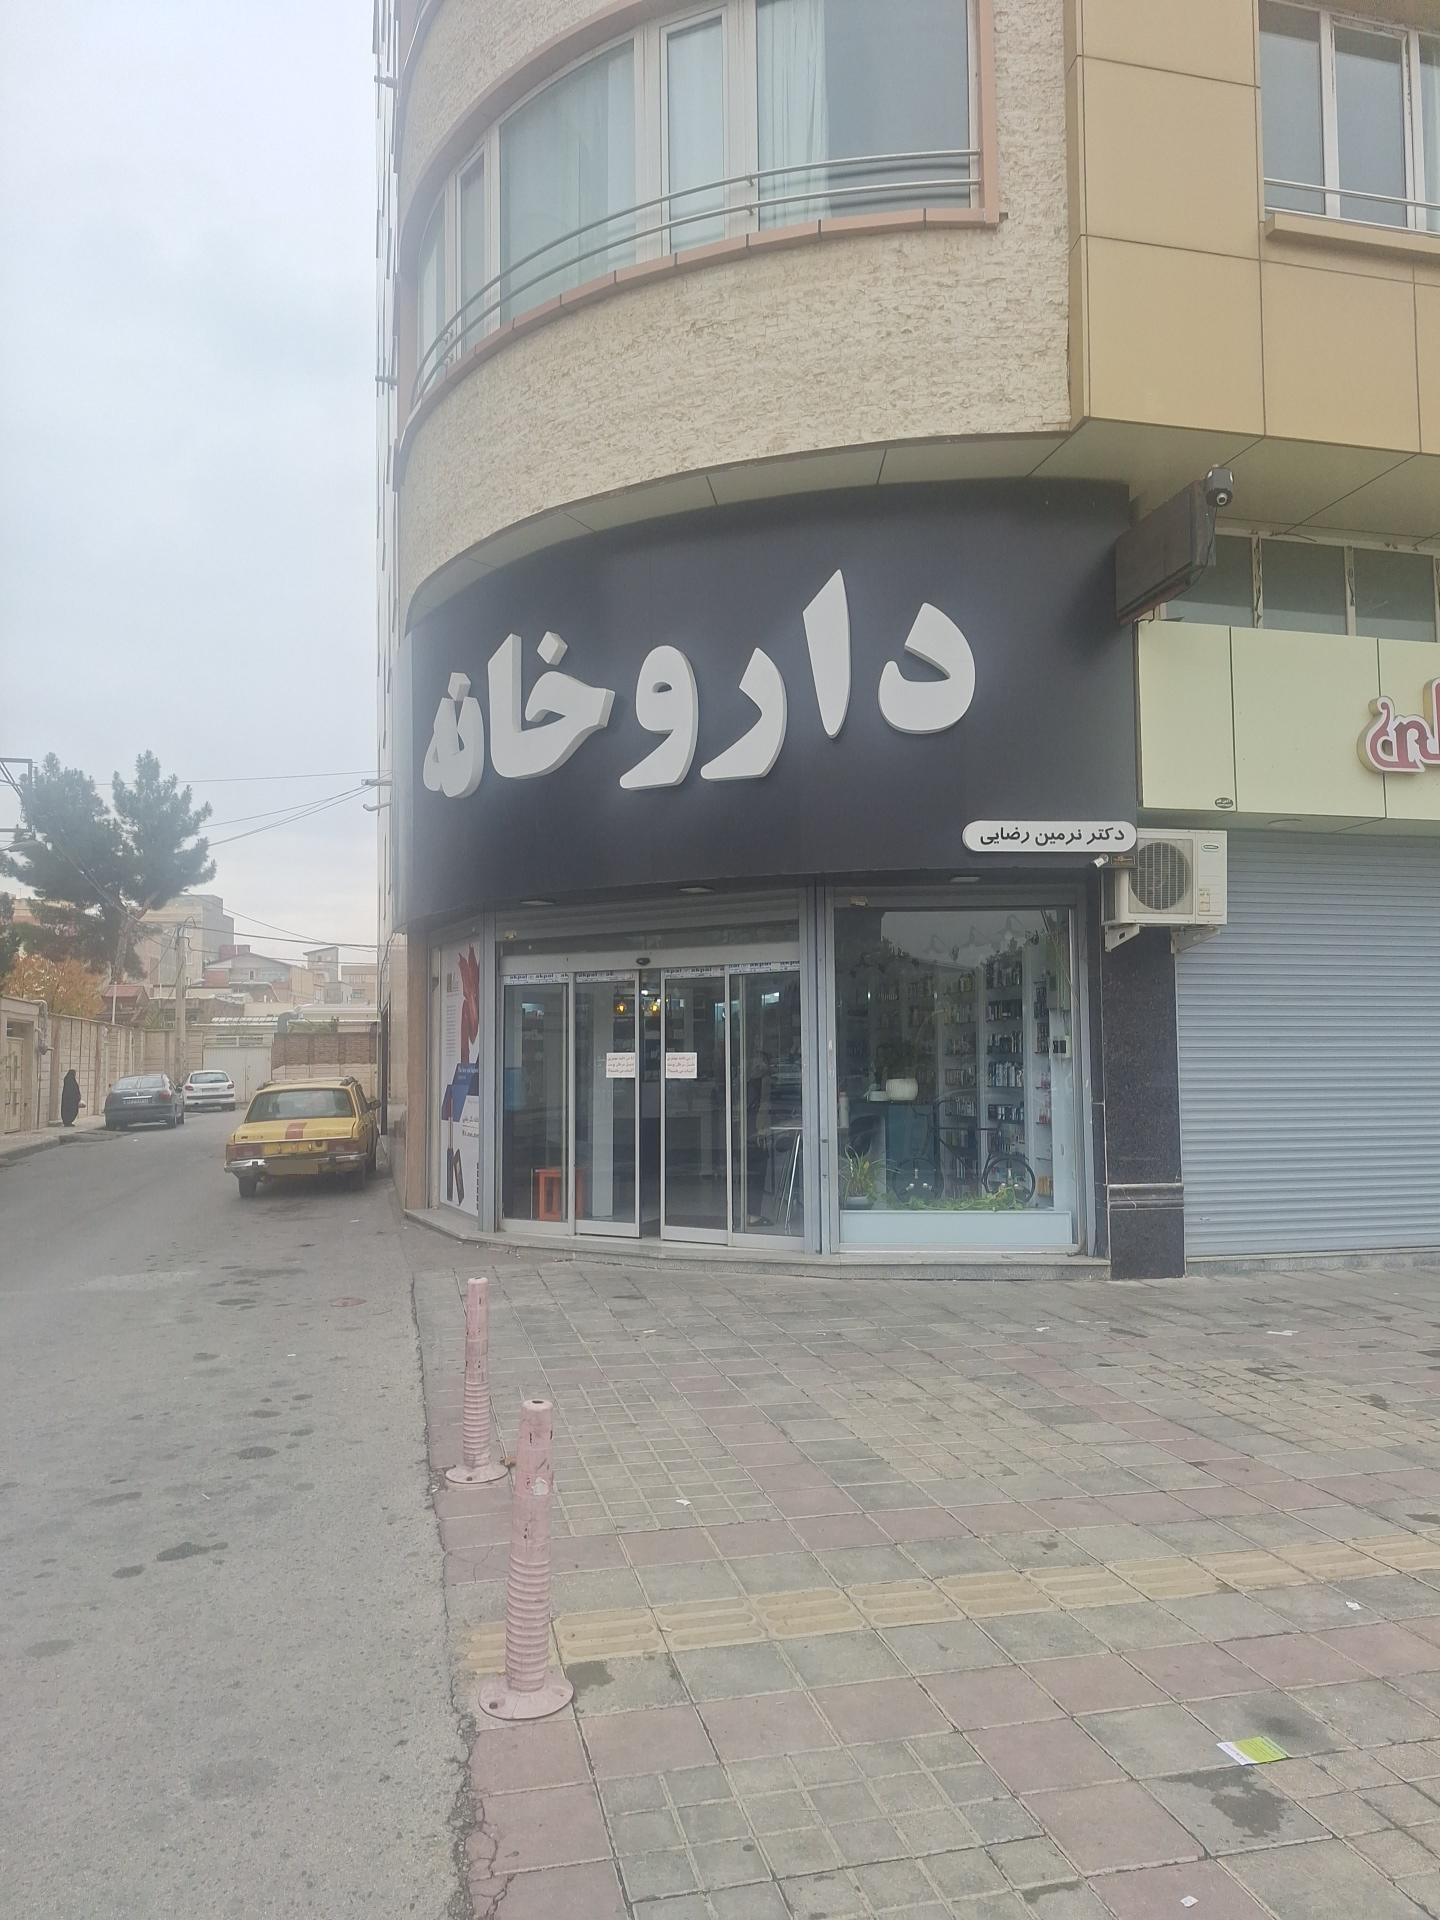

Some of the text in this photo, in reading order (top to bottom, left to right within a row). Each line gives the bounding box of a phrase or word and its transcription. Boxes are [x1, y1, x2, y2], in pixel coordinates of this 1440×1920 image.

[423, 568, 977, 799] داروخانه
[979, 825, 1126, 847] دکتر نرمین رضایی
